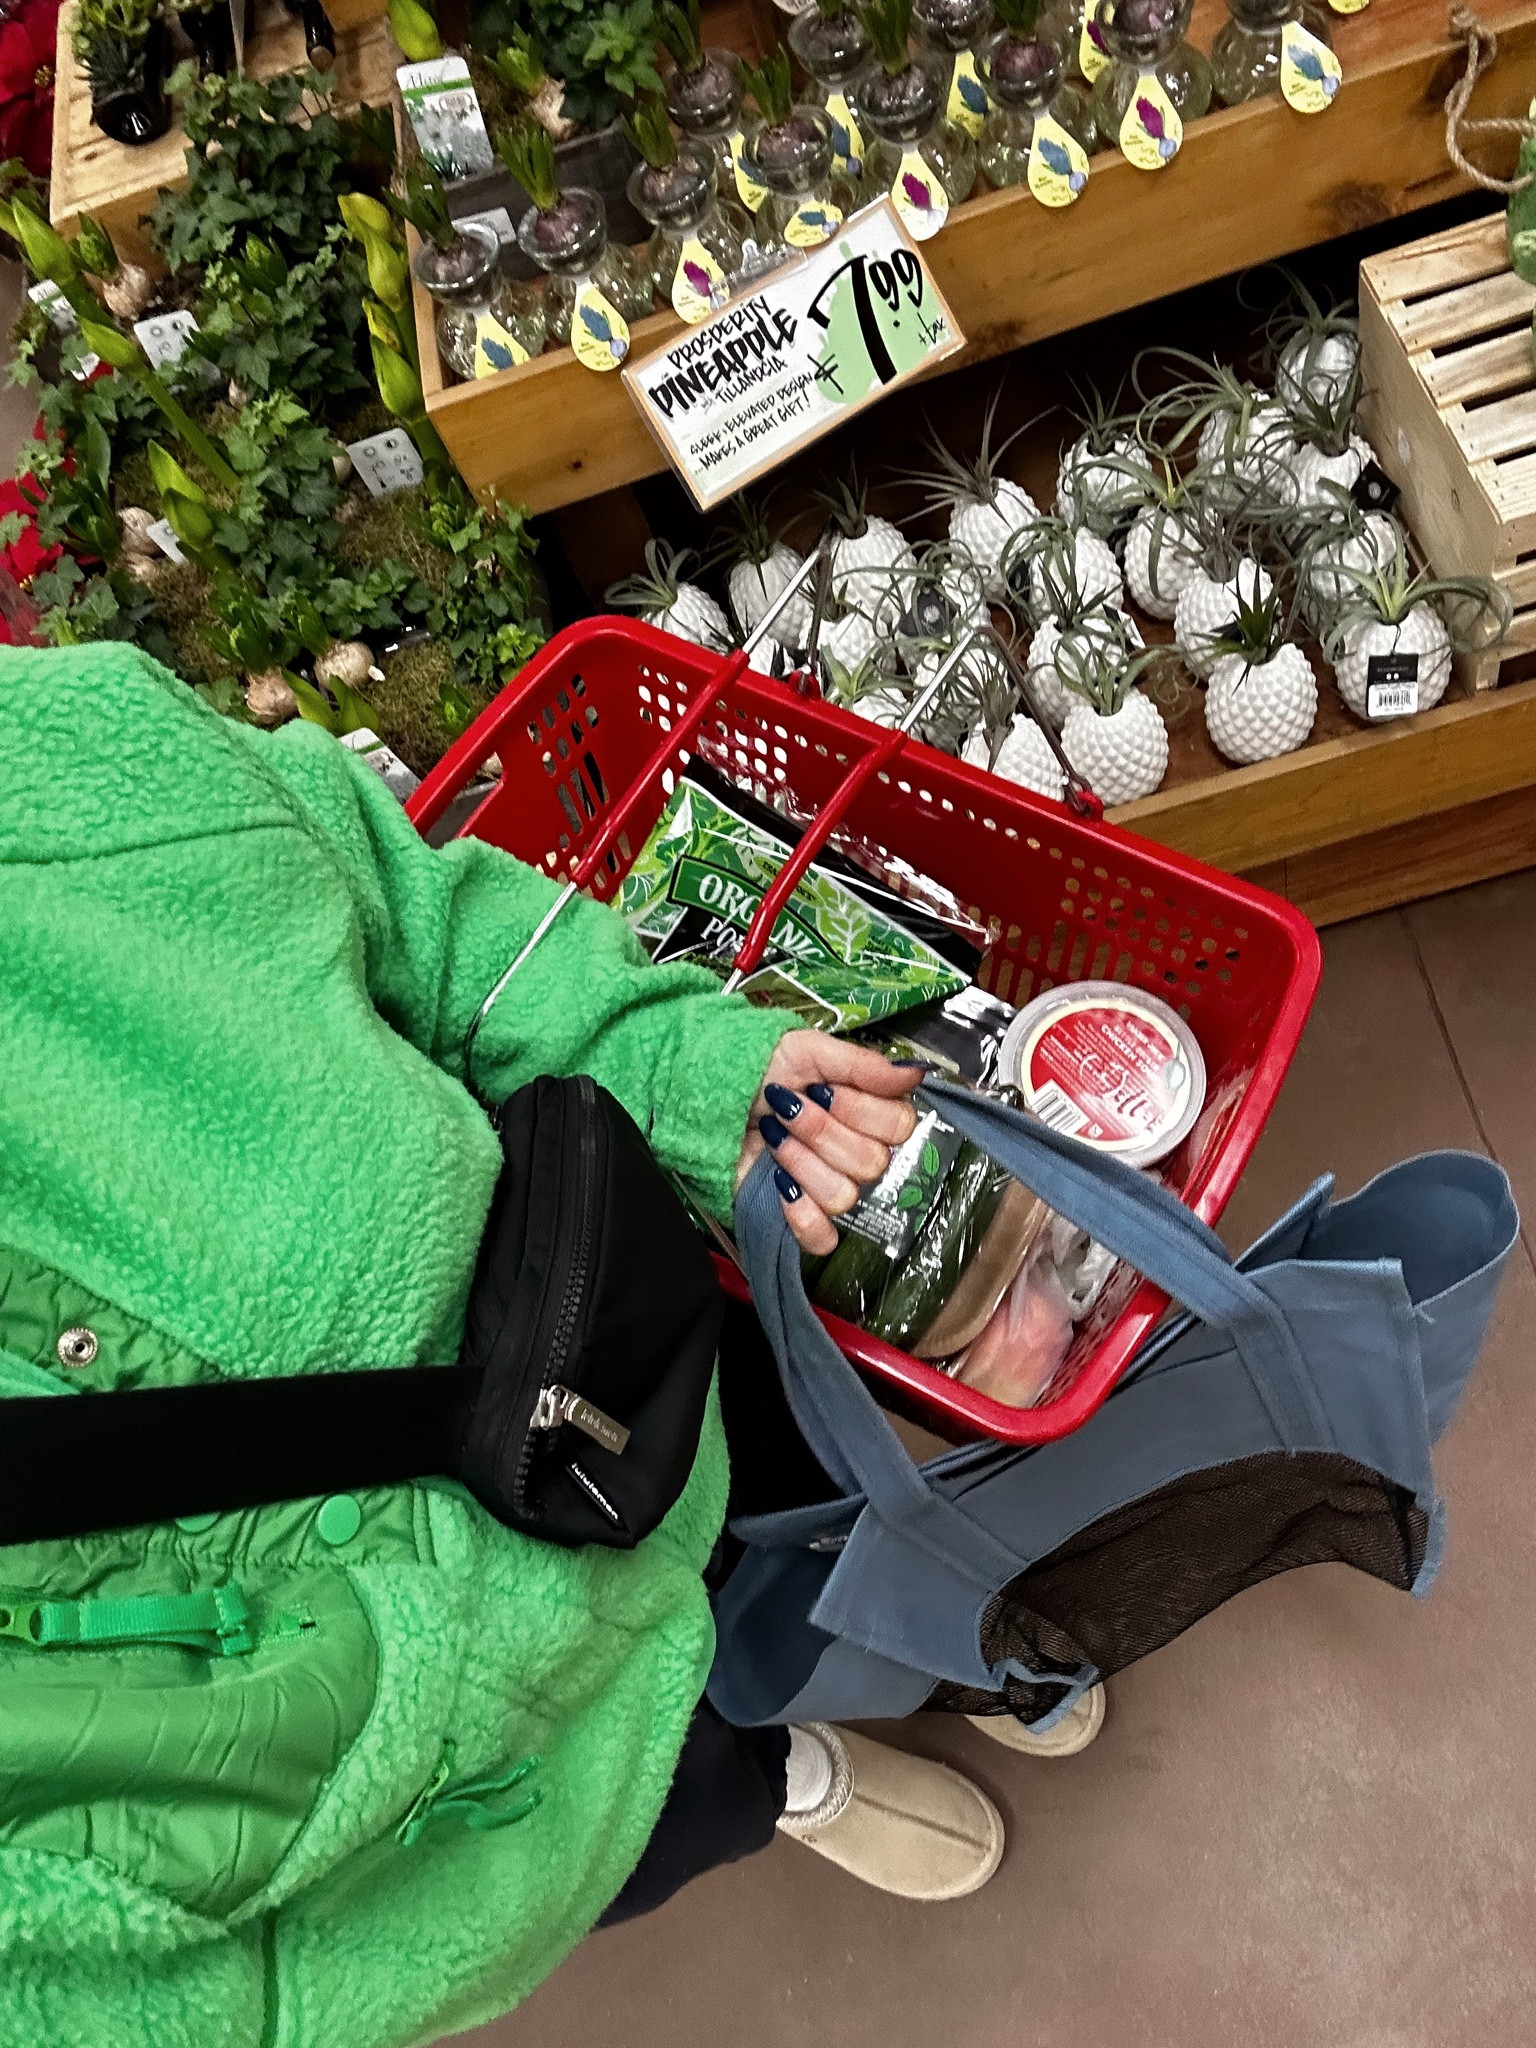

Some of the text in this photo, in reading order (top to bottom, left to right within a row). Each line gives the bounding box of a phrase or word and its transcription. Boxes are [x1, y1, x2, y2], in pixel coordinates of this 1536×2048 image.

[667, 295, 772, 369] PROSPERITY
[648, 308, 798, 418] PINEAPPLE
[724, 394, 775, 433] ELEVATED
[776, 372, 812, 400] DESIGN
[735, 435, 746, 448] A
[743, 414, 779, 443] GREAT
[699, 873, 825, 960] ORGNIC
[1101, 1023, 1137, 1061] CHICKEN
[572, 1462, 618, 1520] lululemon
